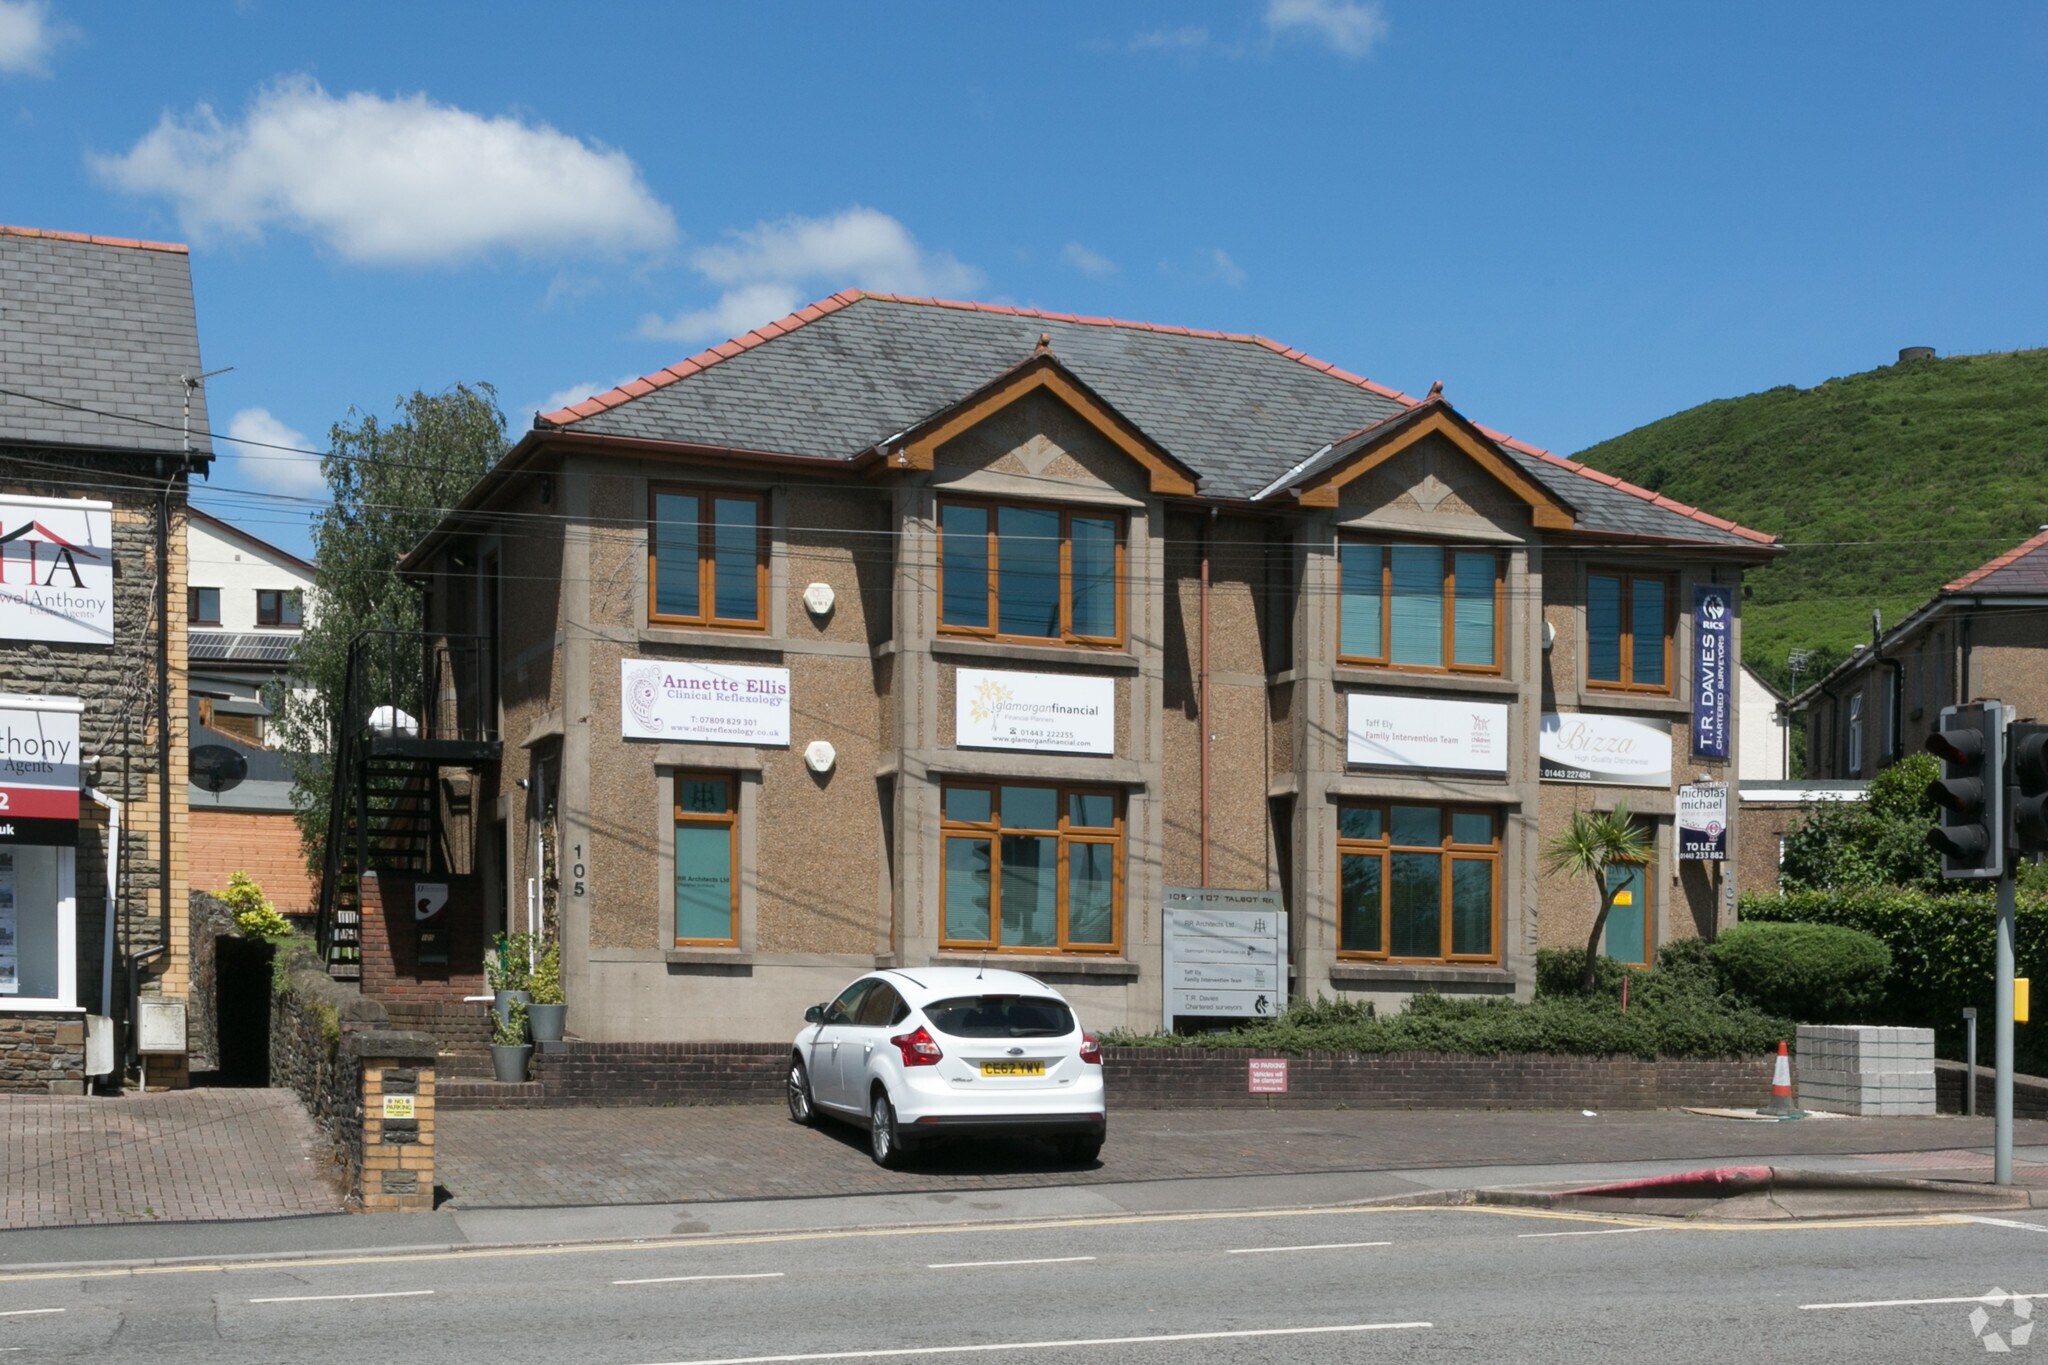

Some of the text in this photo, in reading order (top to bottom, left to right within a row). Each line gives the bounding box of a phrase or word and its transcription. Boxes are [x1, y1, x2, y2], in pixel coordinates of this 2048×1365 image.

[29, 605, 95, 619] Estate Agents
[1703, 621, 1725, 630] RICS
[1702, 634, 1715, 706] DAVIES
[663, 674, 787, 695] Annette Ellis
[667, 689, 783, 707] Clinical Reflexology
[996, 700, 1099, 716] glamorganfinancial
[699, 716, 725, 724] 07809
[726, 717, 742, 725] 829
[744, 719, 758, 727] 301
[1366, 719, 1394, 730] Taff Ely
[1716, 692, 1724, 750] CHARTERED
[1020, 729, 1044, 737] 01443
[1365, 731, 1459, 744] Family Intervention Team
[1557, 720, 1637, 754] Bizza
[1574, 755, 1590, 763] High
[4, 757, 54, 776] Agents
[1544, 769, 1566, 778] 01443
[1681, 788, 1725, 799] nicholas
[1681, 799, 1723, 810] michael
[1686, 843, 1717, 851] TO LET
[574, 844, 585, 898] 105
[1196, 920, 1224, 928] Architects
[985, 1063, 1016, 1075] CE62
